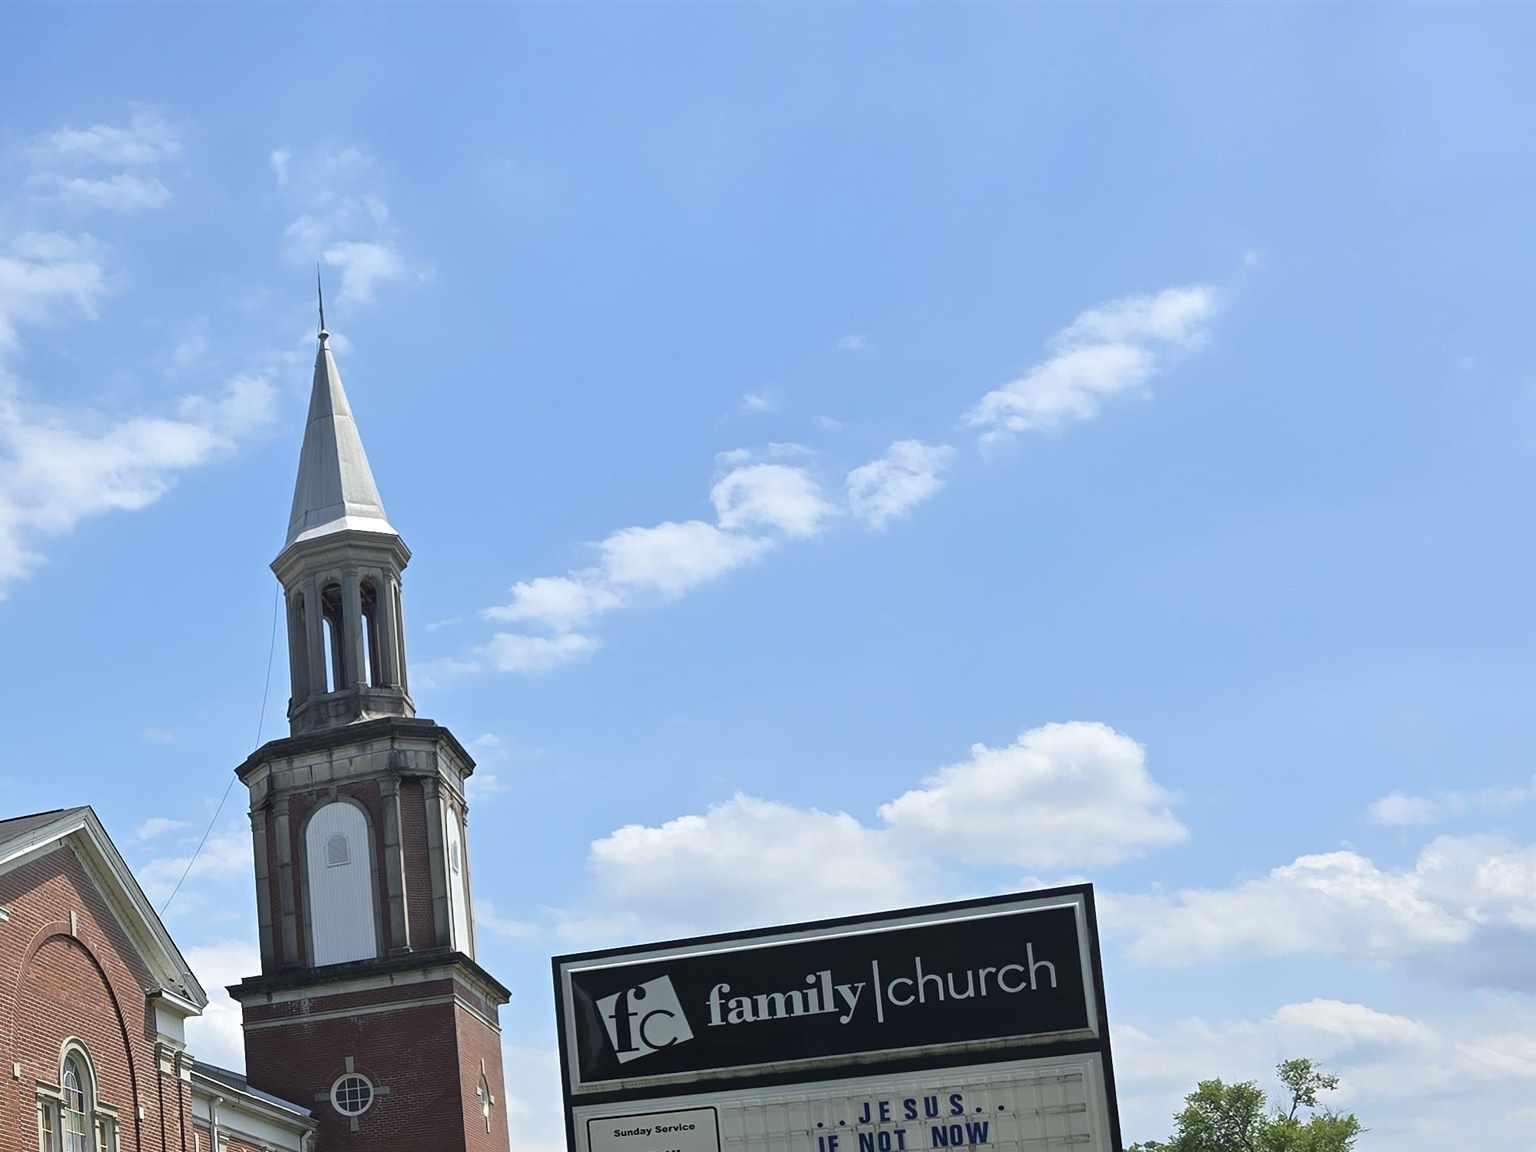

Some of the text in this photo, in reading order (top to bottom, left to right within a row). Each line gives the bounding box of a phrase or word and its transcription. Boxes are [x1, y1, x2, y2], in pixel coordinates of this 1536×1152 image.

[705, 942, 1057, 1026] family church
[613, 1123, 696, 1138] Sunday Service
[931, 1121, 989, 1148] NOW
